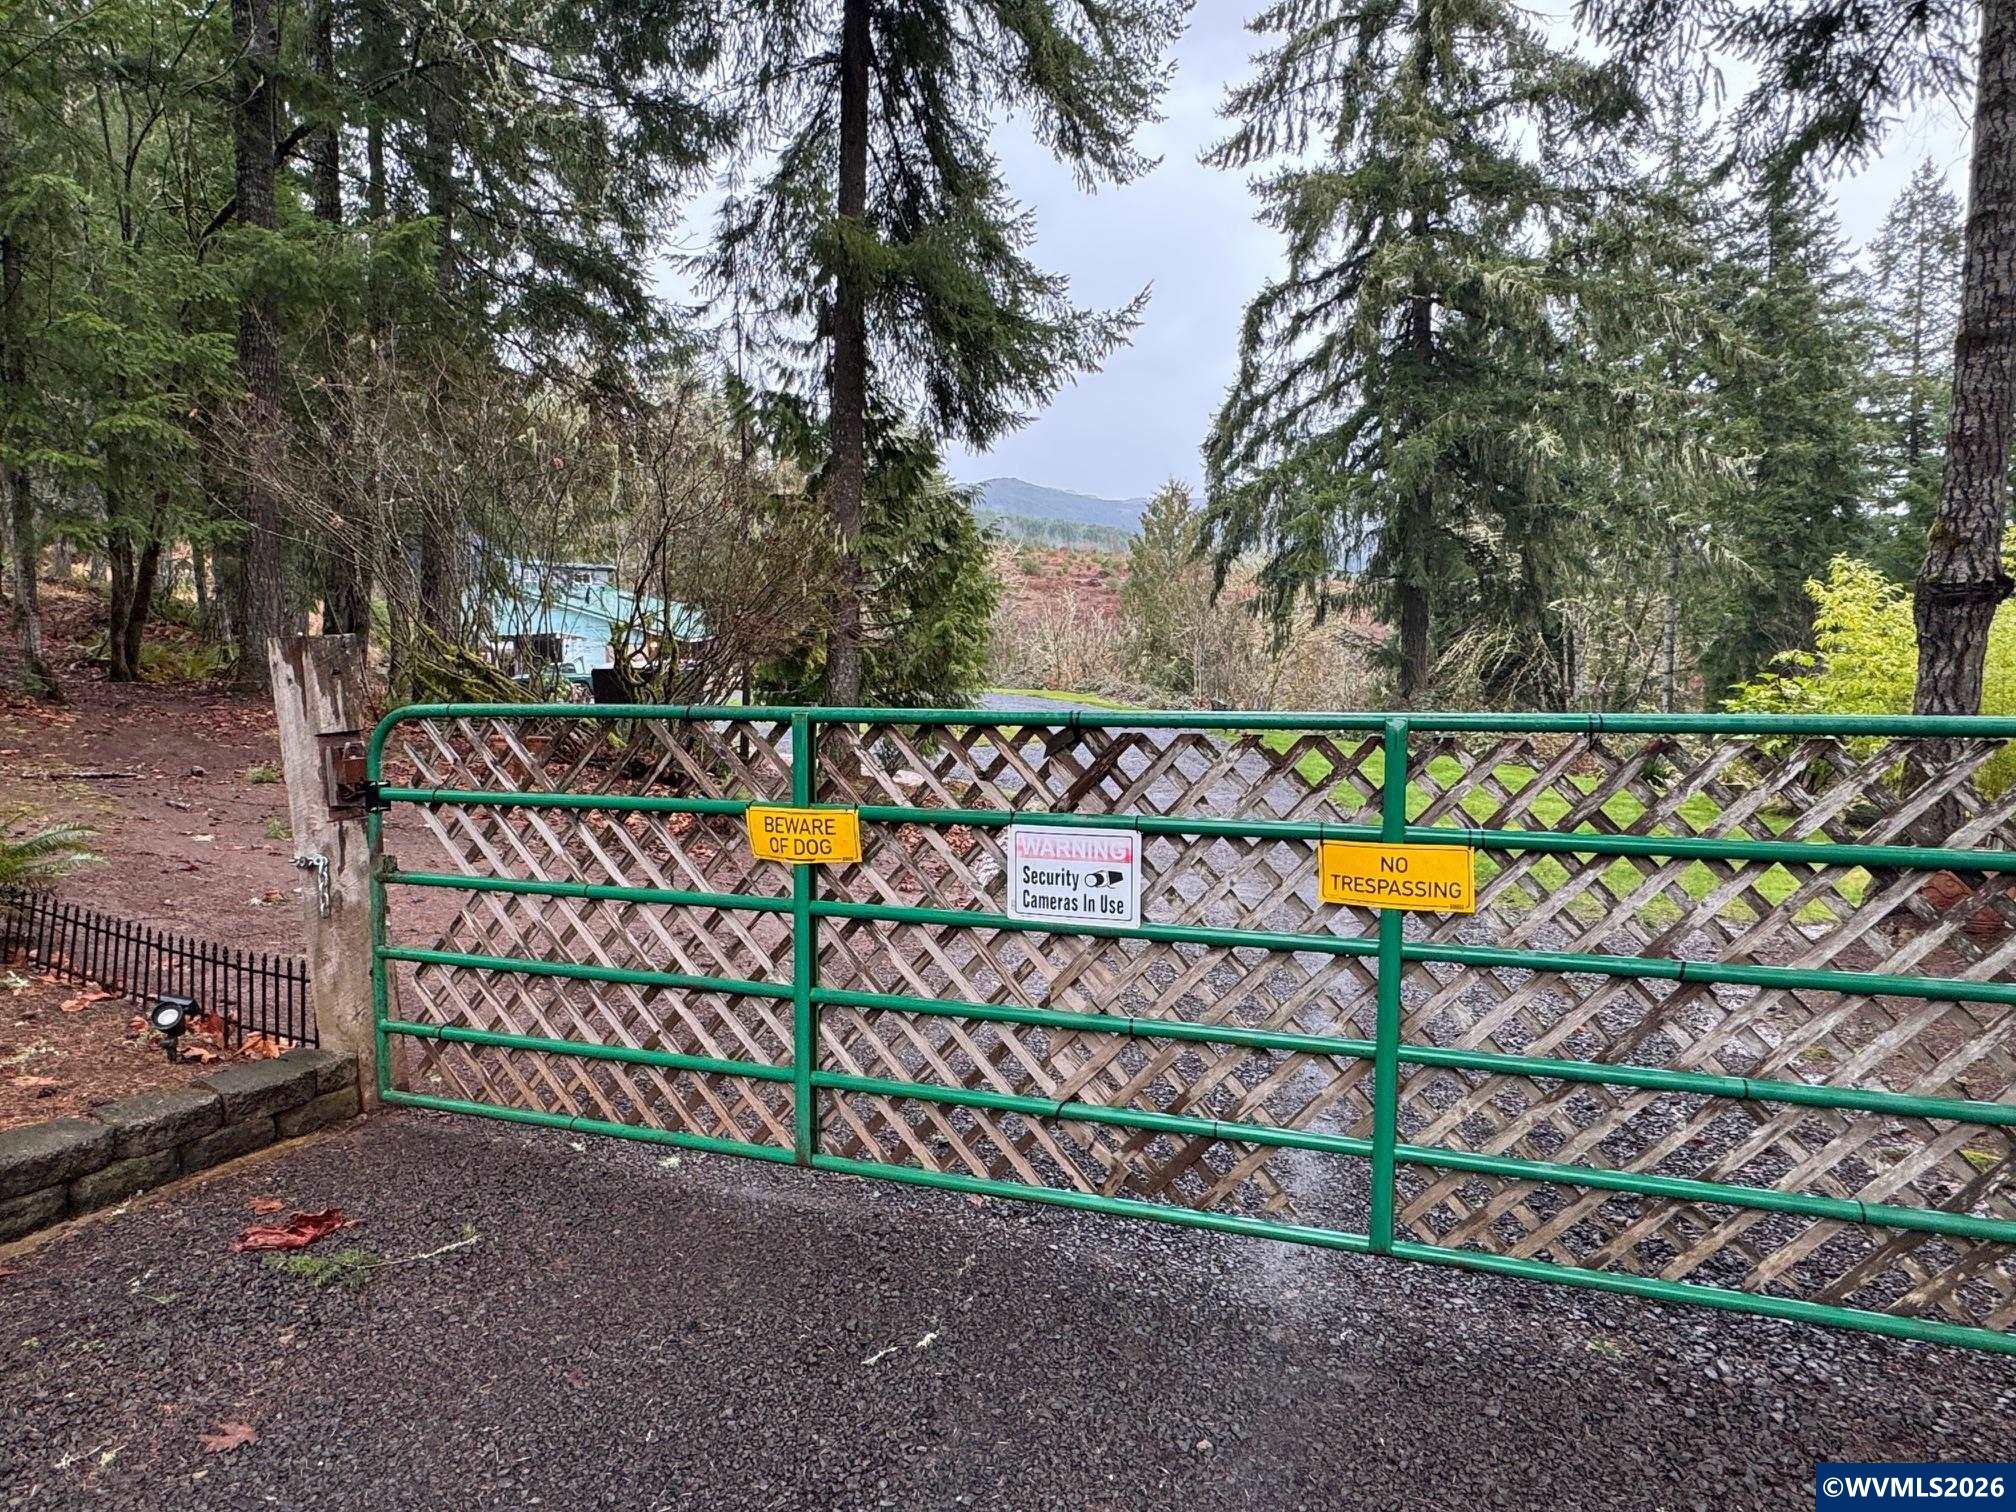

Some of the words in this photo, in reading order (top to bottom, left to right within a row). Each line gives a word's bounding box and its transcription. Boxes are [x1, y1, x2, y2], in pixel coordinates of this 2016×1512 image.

[764, 816, 836, 836] BEWARE
[769, 837, 789, 854] OF
[794, 839, 832, 856] DOG
[1021, 837, 1127, 860] WARNING
[1380, 856, 1408, 874] NO
[1022, 865, 1079, 891] Security
[1330, 873, 1462, 899] TRESPASSING
[1022, 889, 1078, 912] Cameras
[1083, 893, 1095, 913] In
[1100, 894, 1124, 915] Use
